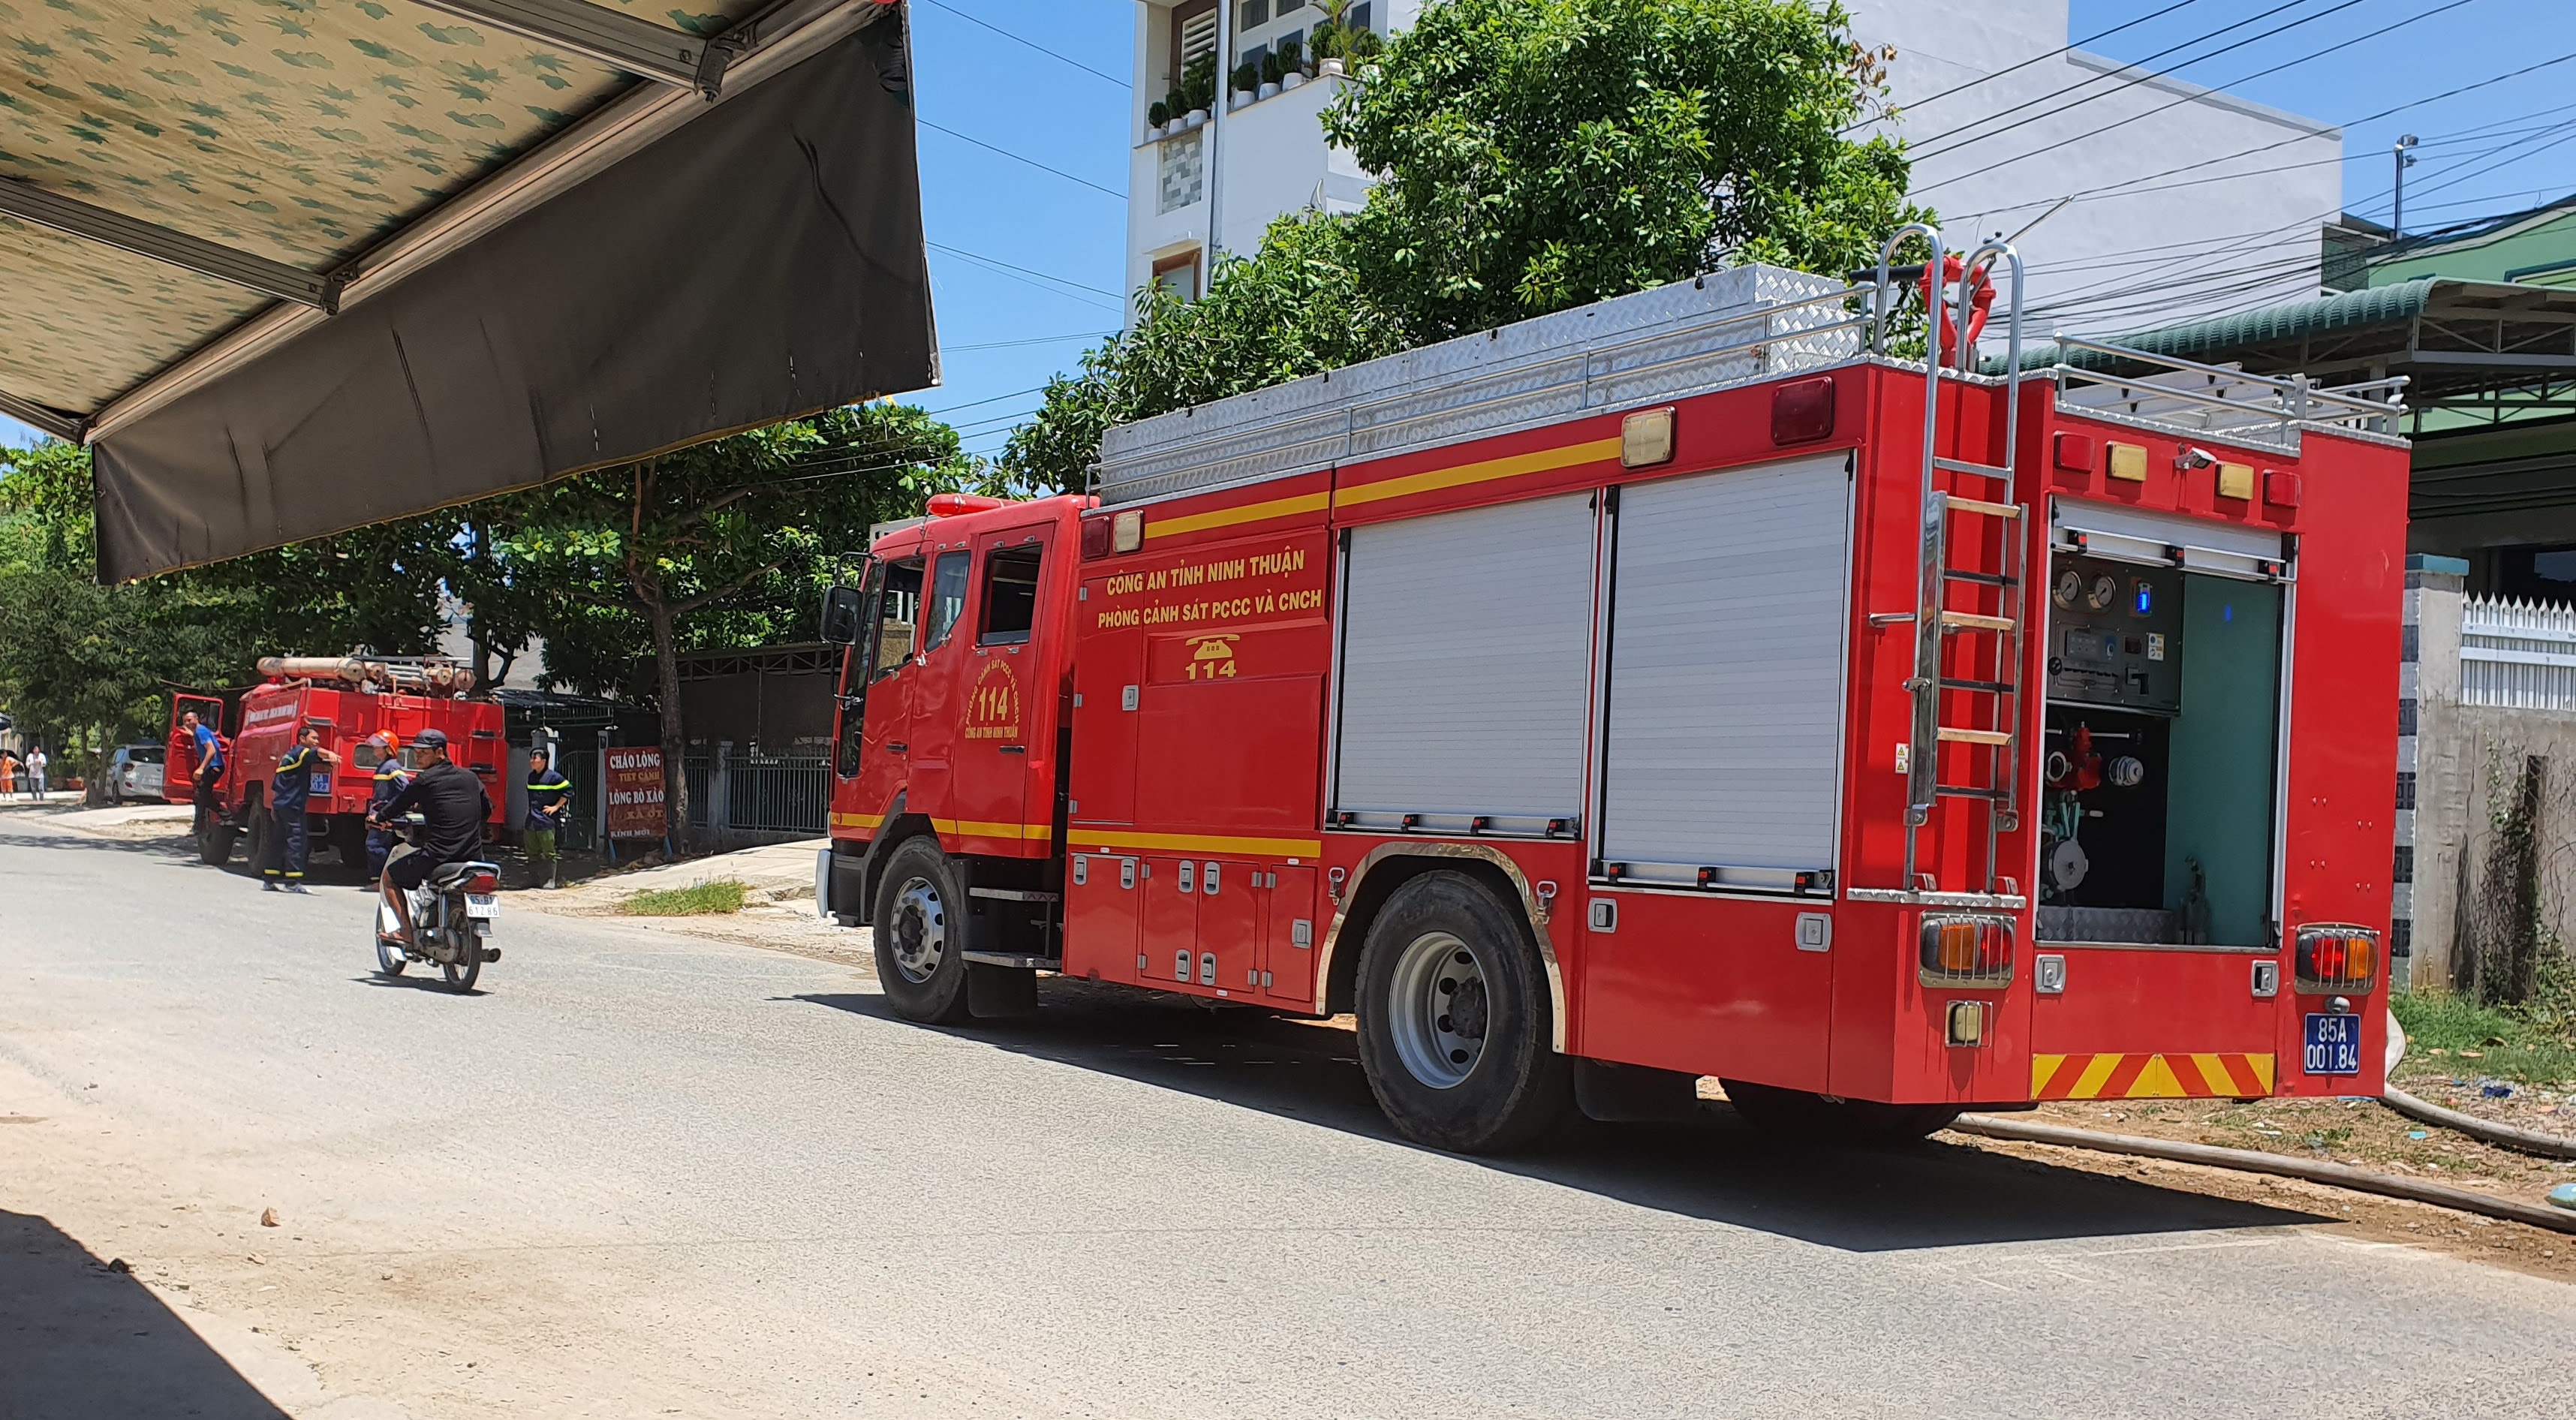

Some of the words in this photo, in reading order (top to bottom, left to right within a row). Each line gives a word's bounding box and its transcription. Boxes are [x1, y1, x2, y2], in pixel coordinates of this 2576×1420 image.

[1107, 570, 1143, 595] CÔNG
[1146, 571, 1166, 591] AN
[1171, 559, 1203, 586] TỈNH
[1208, 559, 1244, 582] NINH
[1250, 546, 1305, 578] THUẬN
[1098, 605, 1139, 628] PHÒNG
[1143, 599, 1178, 624] CẢNH
[1182, 598, 1208, 621] SÁT
[1211, 599, 1250, 618] PCCC
[1255, 588, 1274, 614] VÀ
[1278, 589, 1322, 611] CNCH
[1185, 660, 1236, 680] 114
[979, 686, 1008, 721] 114
[609, 751, 634, 769] CHÁO
[636, 751, 660, 768] LÒNG
[609, 788, 631, 805] LÒNG
[633, 788, 645, 804] BÒ
[646, 787, 664, 803] XÀO
[2318, 1018, 2347, 1042] 85A
[2307, 1044, 2357, 1070] 001.84
